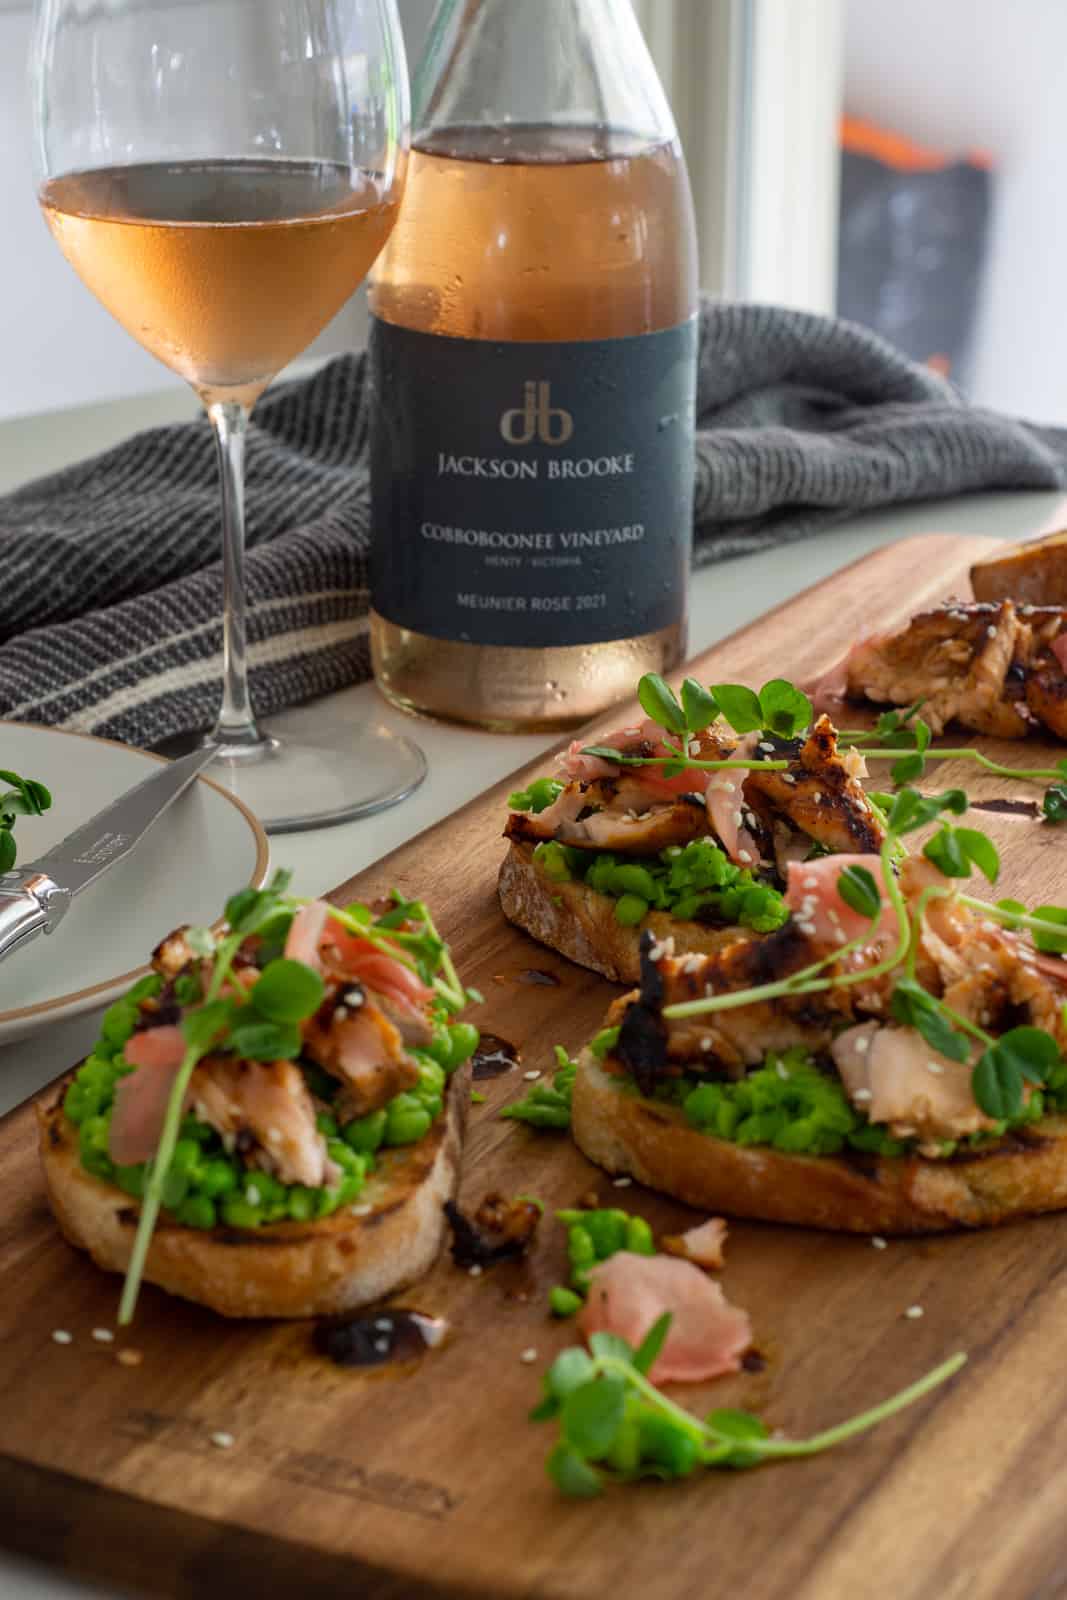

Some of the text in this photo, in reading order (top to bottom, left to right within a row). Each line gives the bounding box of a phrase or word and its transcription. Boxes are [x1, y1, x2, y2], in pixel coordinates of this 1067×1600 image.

[438, 452, 635, 479] JACKSON BROOKE
[421, 522, 645, 549] COBBOBOONEE VINEYARD
[456, 593, 528, 611] MEUNIER
[575, 593, 607, 610] 2021
